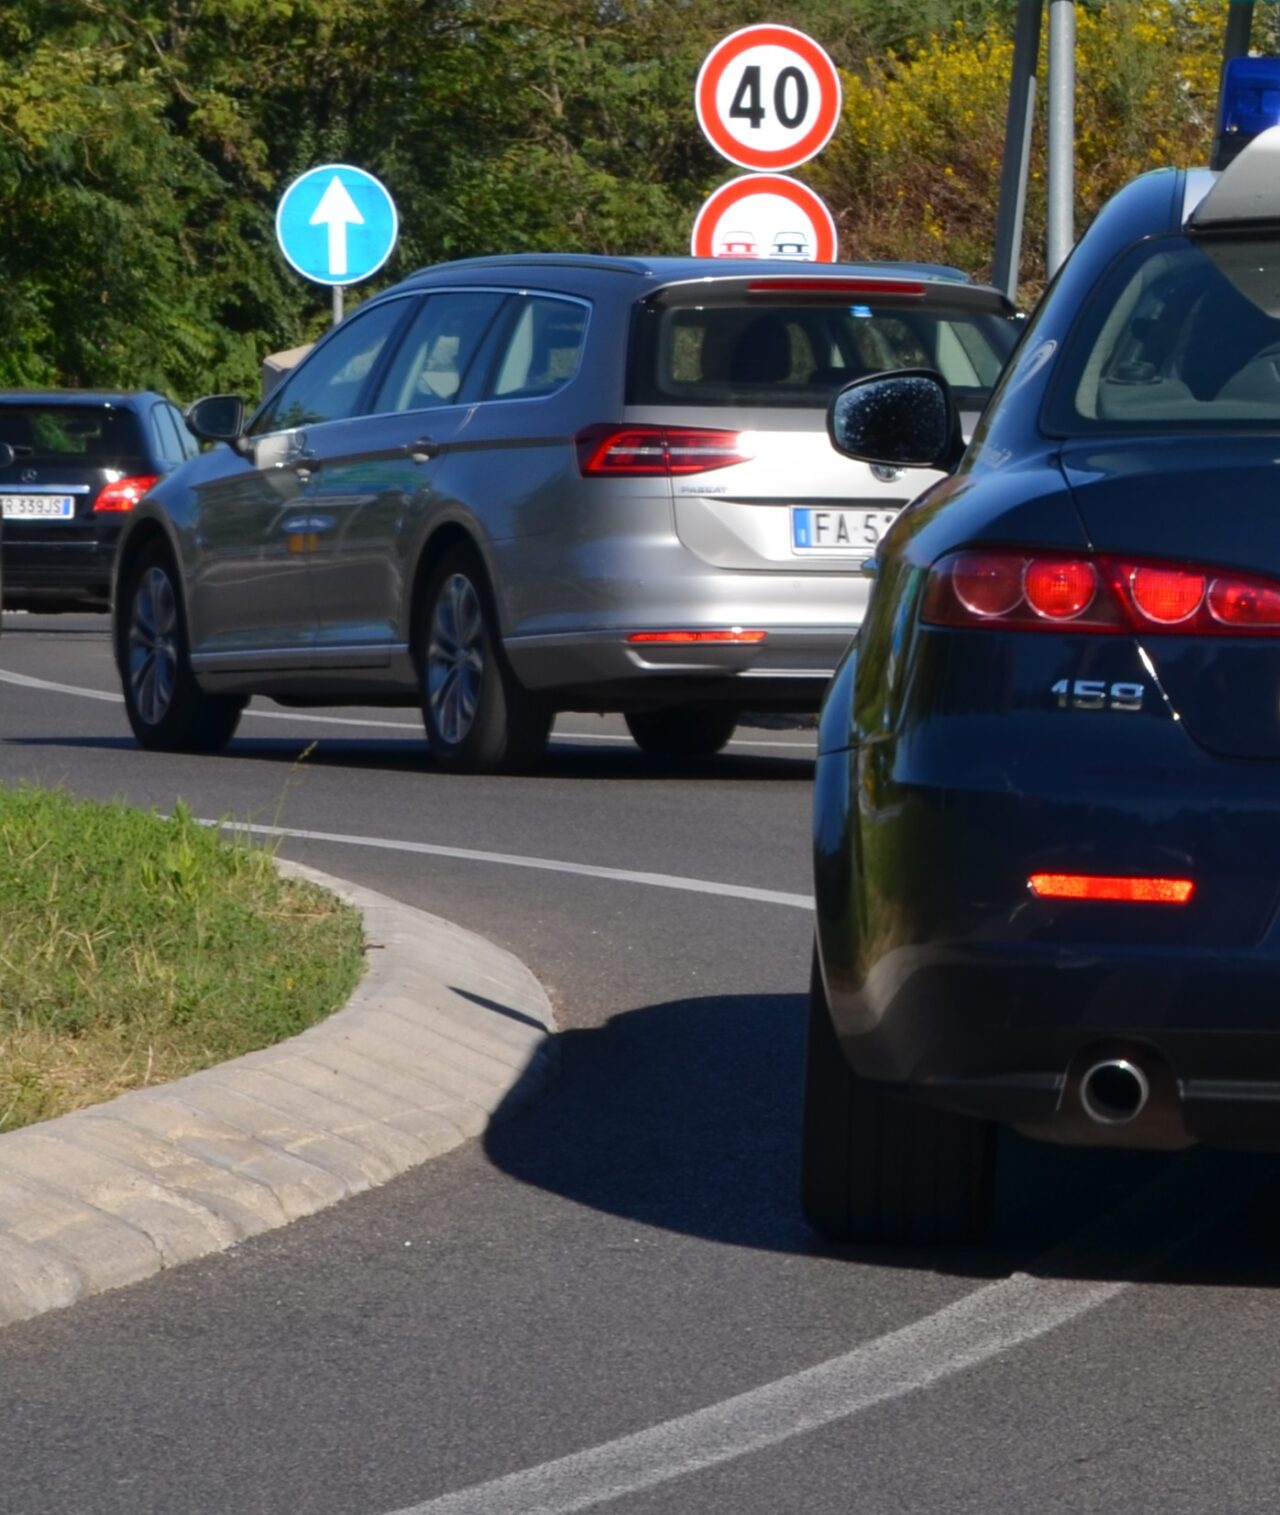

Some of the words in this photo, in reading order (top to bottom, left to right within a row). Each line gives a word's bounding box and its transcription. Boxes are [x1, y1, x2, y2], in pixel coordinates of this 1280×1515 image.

[729, 65, 809, 129] 40
[19, 499, 61, 513] 339JS
[1050, 679, 1144, 711] 159
